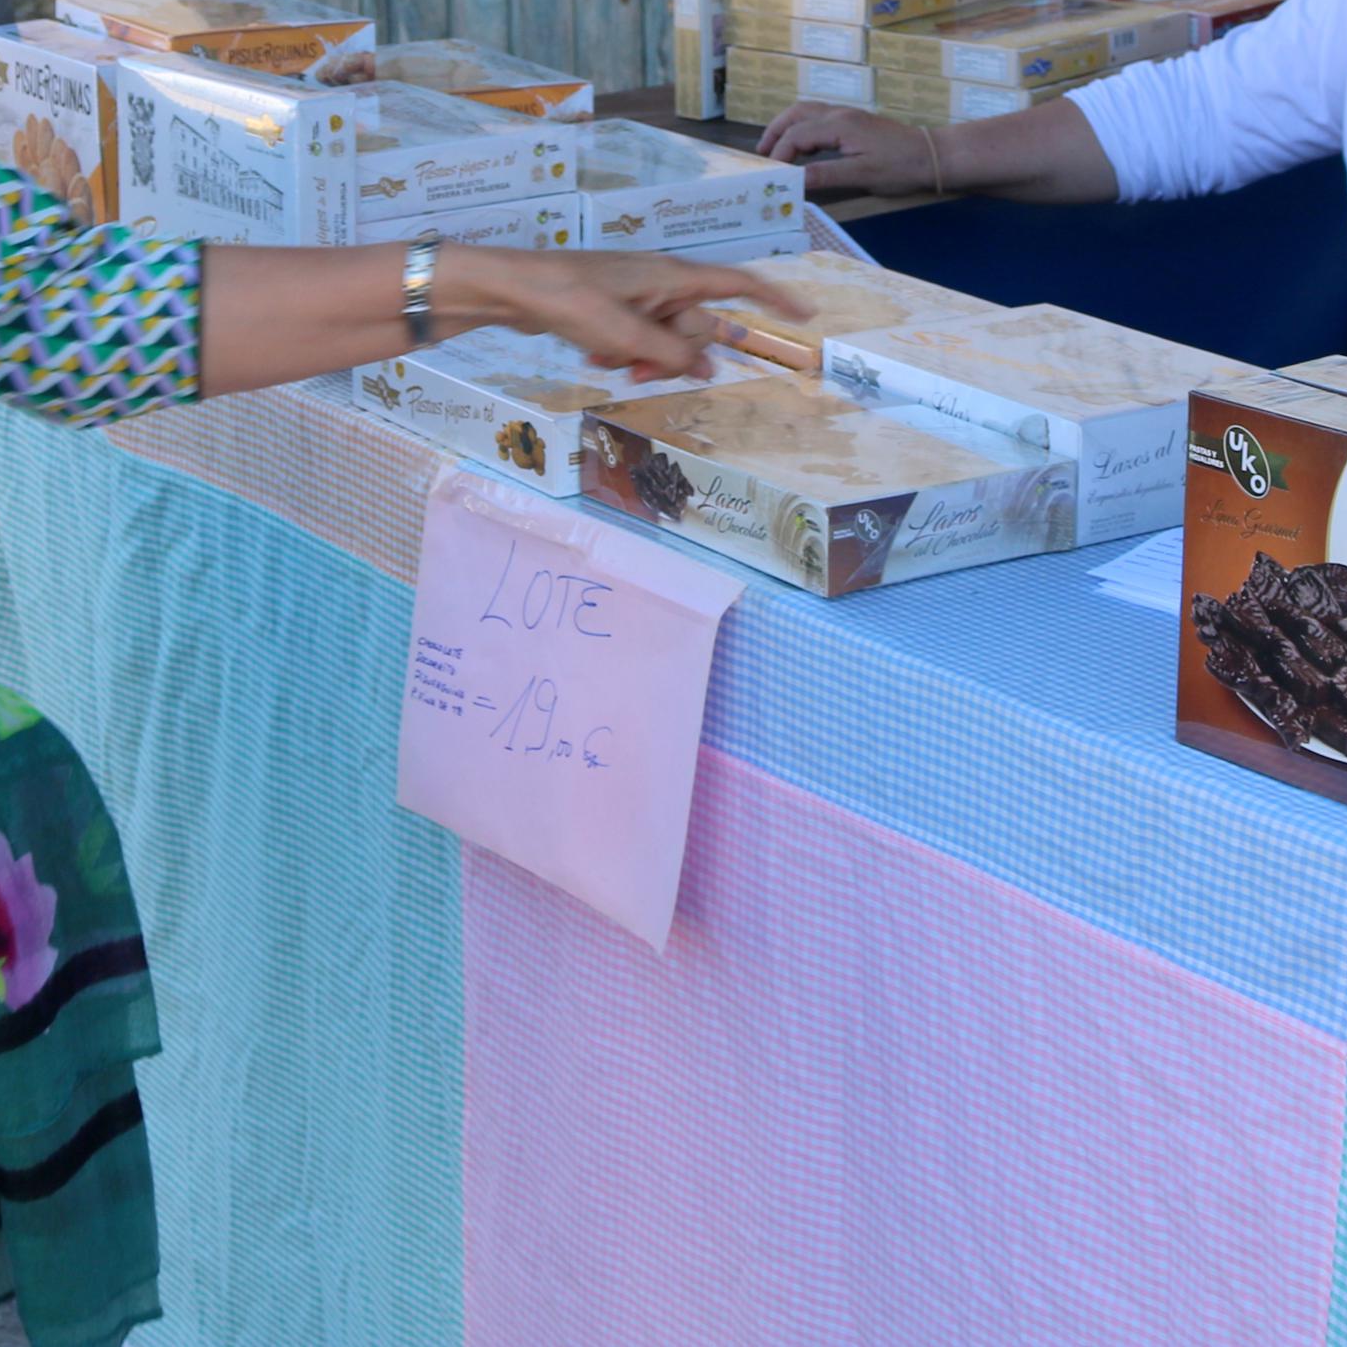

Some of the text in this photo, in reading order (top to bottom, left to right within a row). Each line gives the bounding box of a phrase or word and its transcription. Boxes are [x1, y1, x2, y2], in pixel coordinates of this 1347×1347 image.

[1092, 430, 1176, 480] Lazos al
[697, 475, 752, 515] Lazos
[717, 513, 769, 542] Chocolate
[905, 501, 983, 549] Lazos
[479, 539, 613, 637] LOTE
